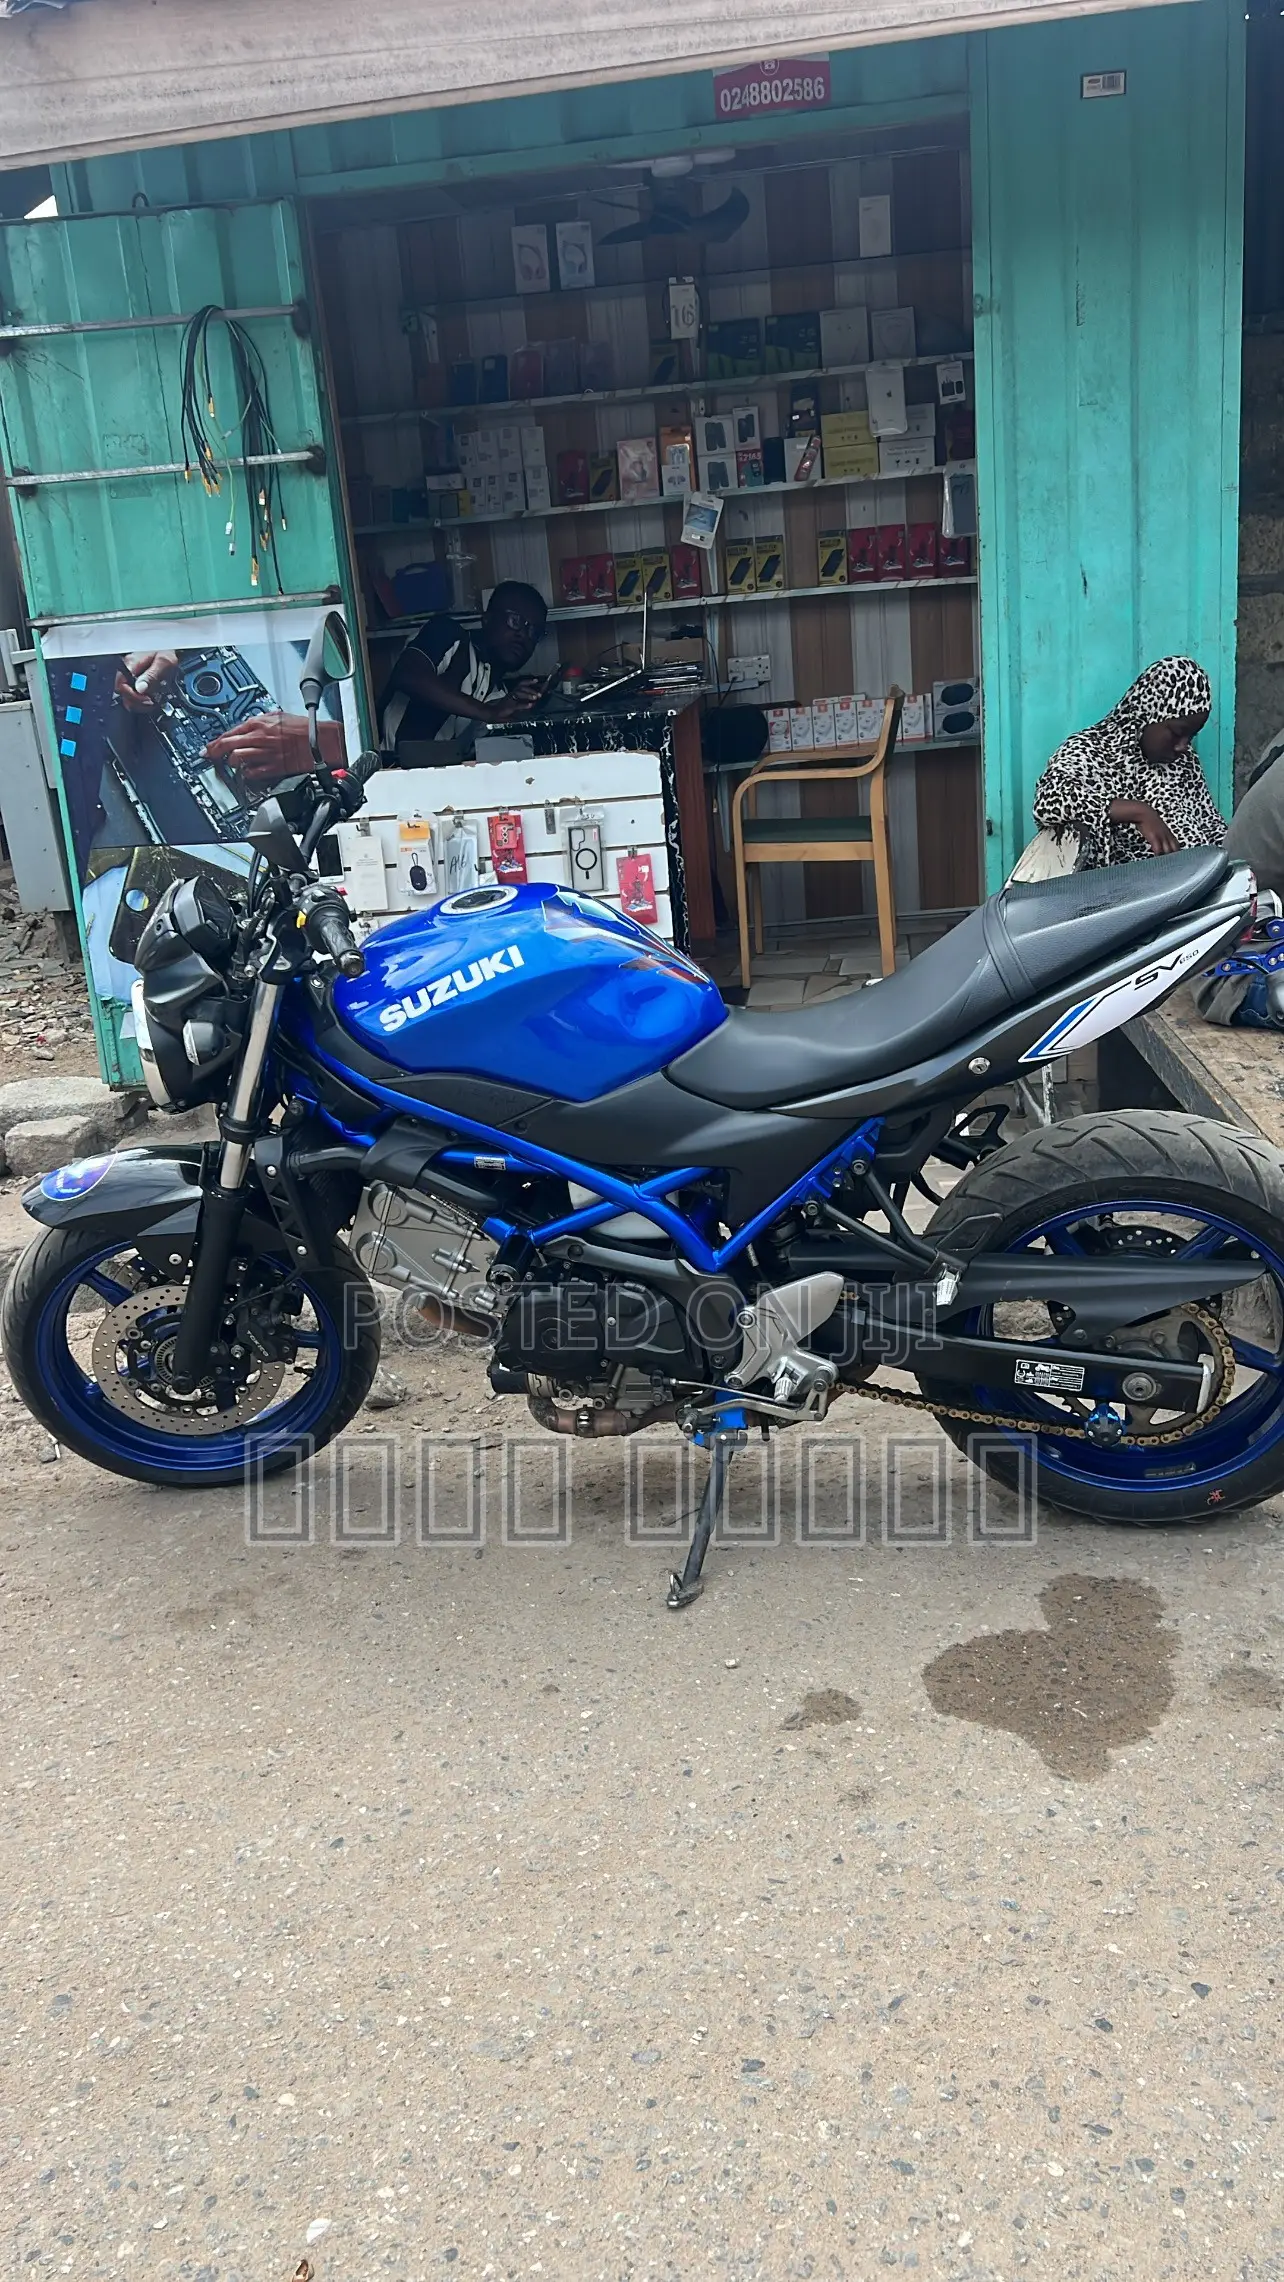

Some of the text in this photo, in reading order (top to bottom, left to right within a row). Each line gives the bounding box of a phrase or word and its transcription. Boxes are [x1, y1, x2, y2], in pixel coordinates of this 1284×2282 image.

[720, 77, 825, 112] 0248802586
[449, 854, 467, 875] A16
[379, 944, 525, 1032] SUZUKI
